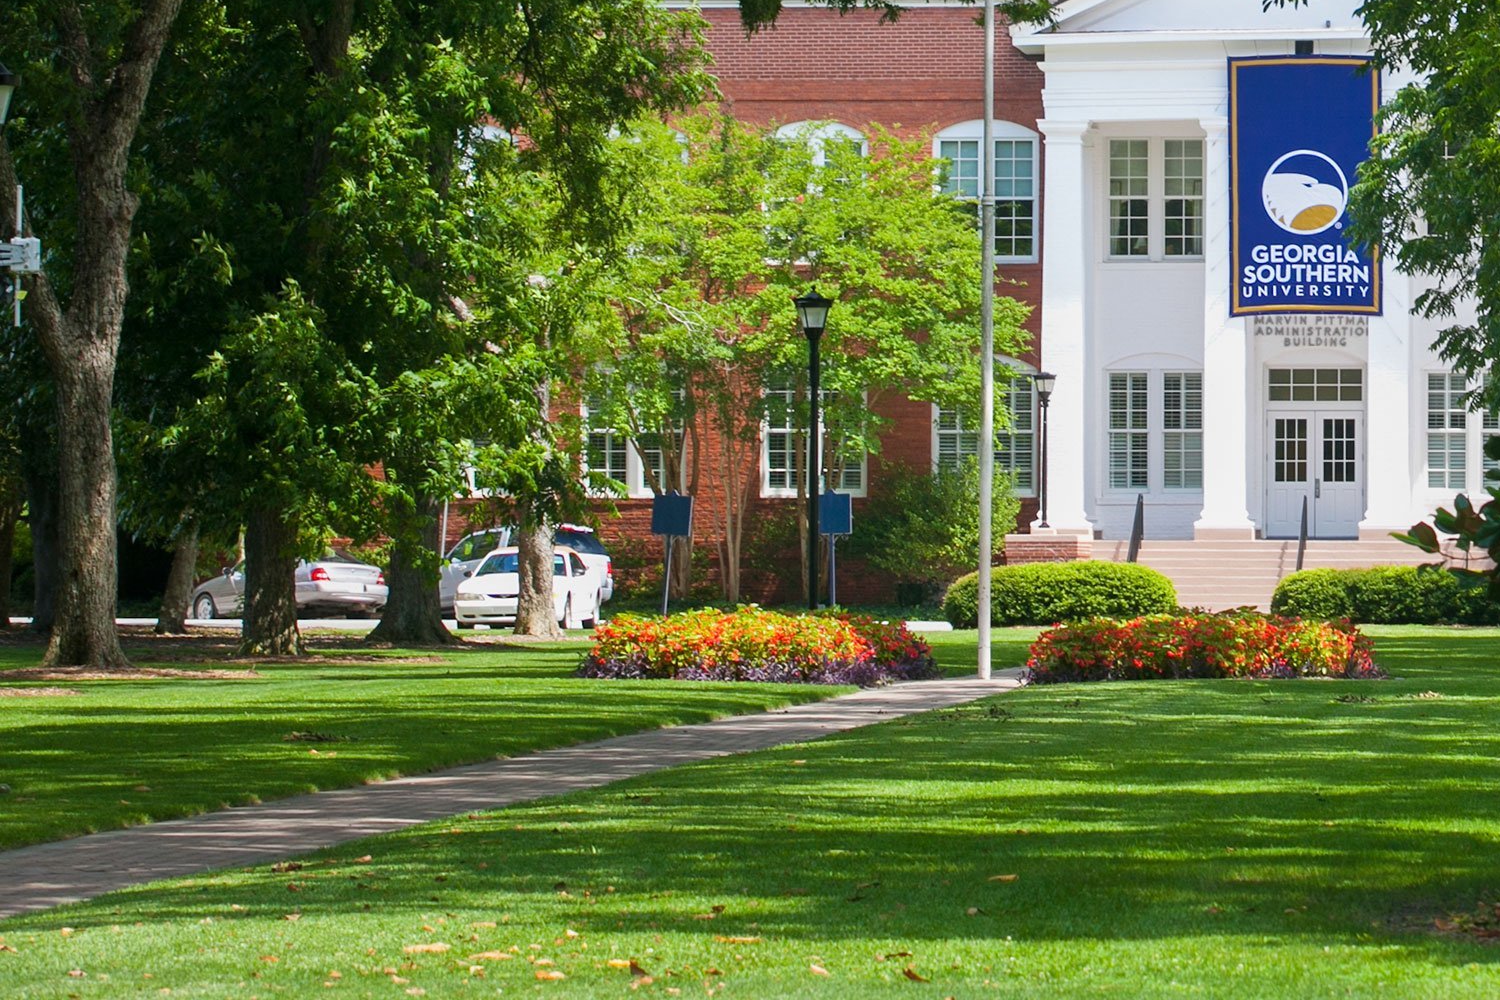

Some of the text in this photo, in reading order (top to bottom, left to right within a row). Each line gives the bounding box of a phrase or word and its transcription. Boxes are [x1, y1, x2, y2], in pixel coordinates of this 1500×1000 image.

[1251, 244, 1360, 264] GEORGIA
[1243, 264, 1369, 284] SOUTHERN
[1242, 285, 1369, 298] UNIVERSITY
[1254, 315, 1369, 325] MARVIN PITTMA
[1254, 327, 1369, 336] ADMINISTRATIO
[1283, 337, 1347, 347] BUILDING
